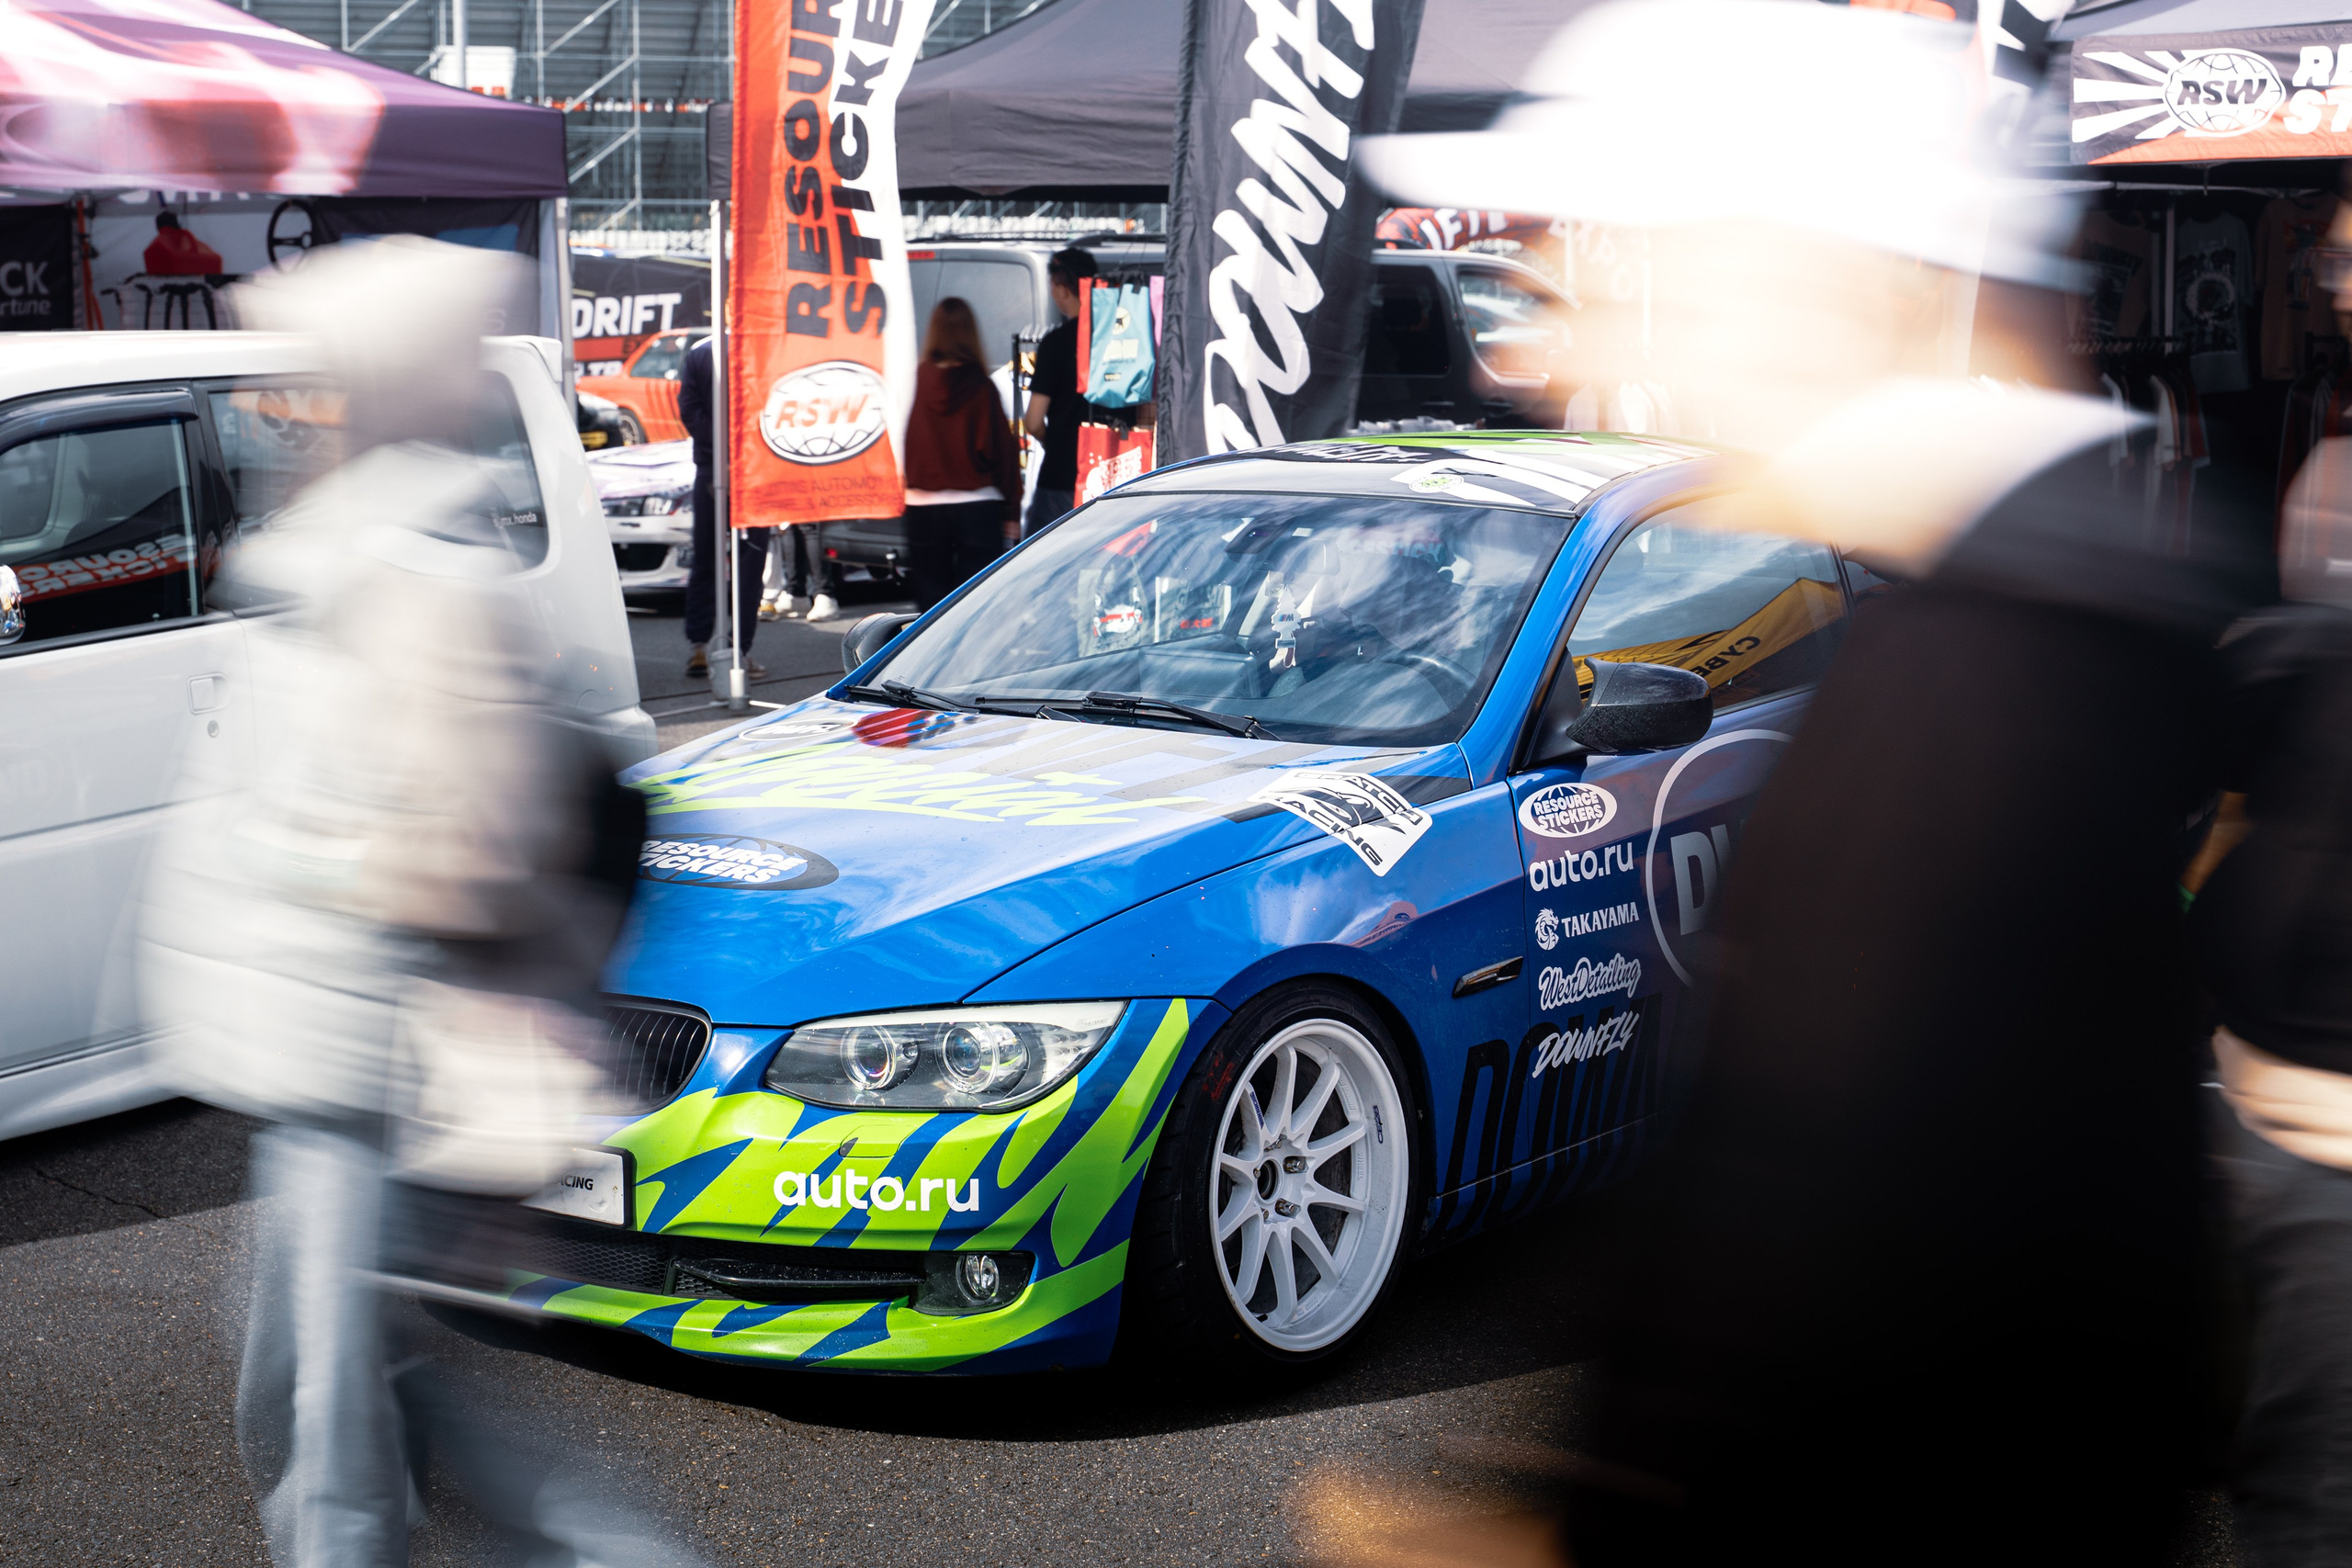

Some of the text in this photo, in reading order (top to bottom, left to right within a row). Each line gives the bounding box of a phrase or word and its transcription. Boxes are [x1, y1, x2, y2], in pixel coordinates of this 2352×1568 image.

[2177, 78, 2267, 107] RSW
[571, 292, 683, 339] DRIFT
[775, 394, 869, 430] RSW
[1532, 791, 1600, 816] RESOURCE
[1537, 804, 1604, 829] STICKERS
[638, 852, 781, 883] TICKERS
[1529, 841, 1634, 892] auto.ru
[1561, 901, 1640, 938] TAKAYAMA
[1532, 1010, 1640, 1078] DOWNFLY
[556, 1174, 594, 1191] ACING
[774, 1168, 979, 1213] auto.ru
